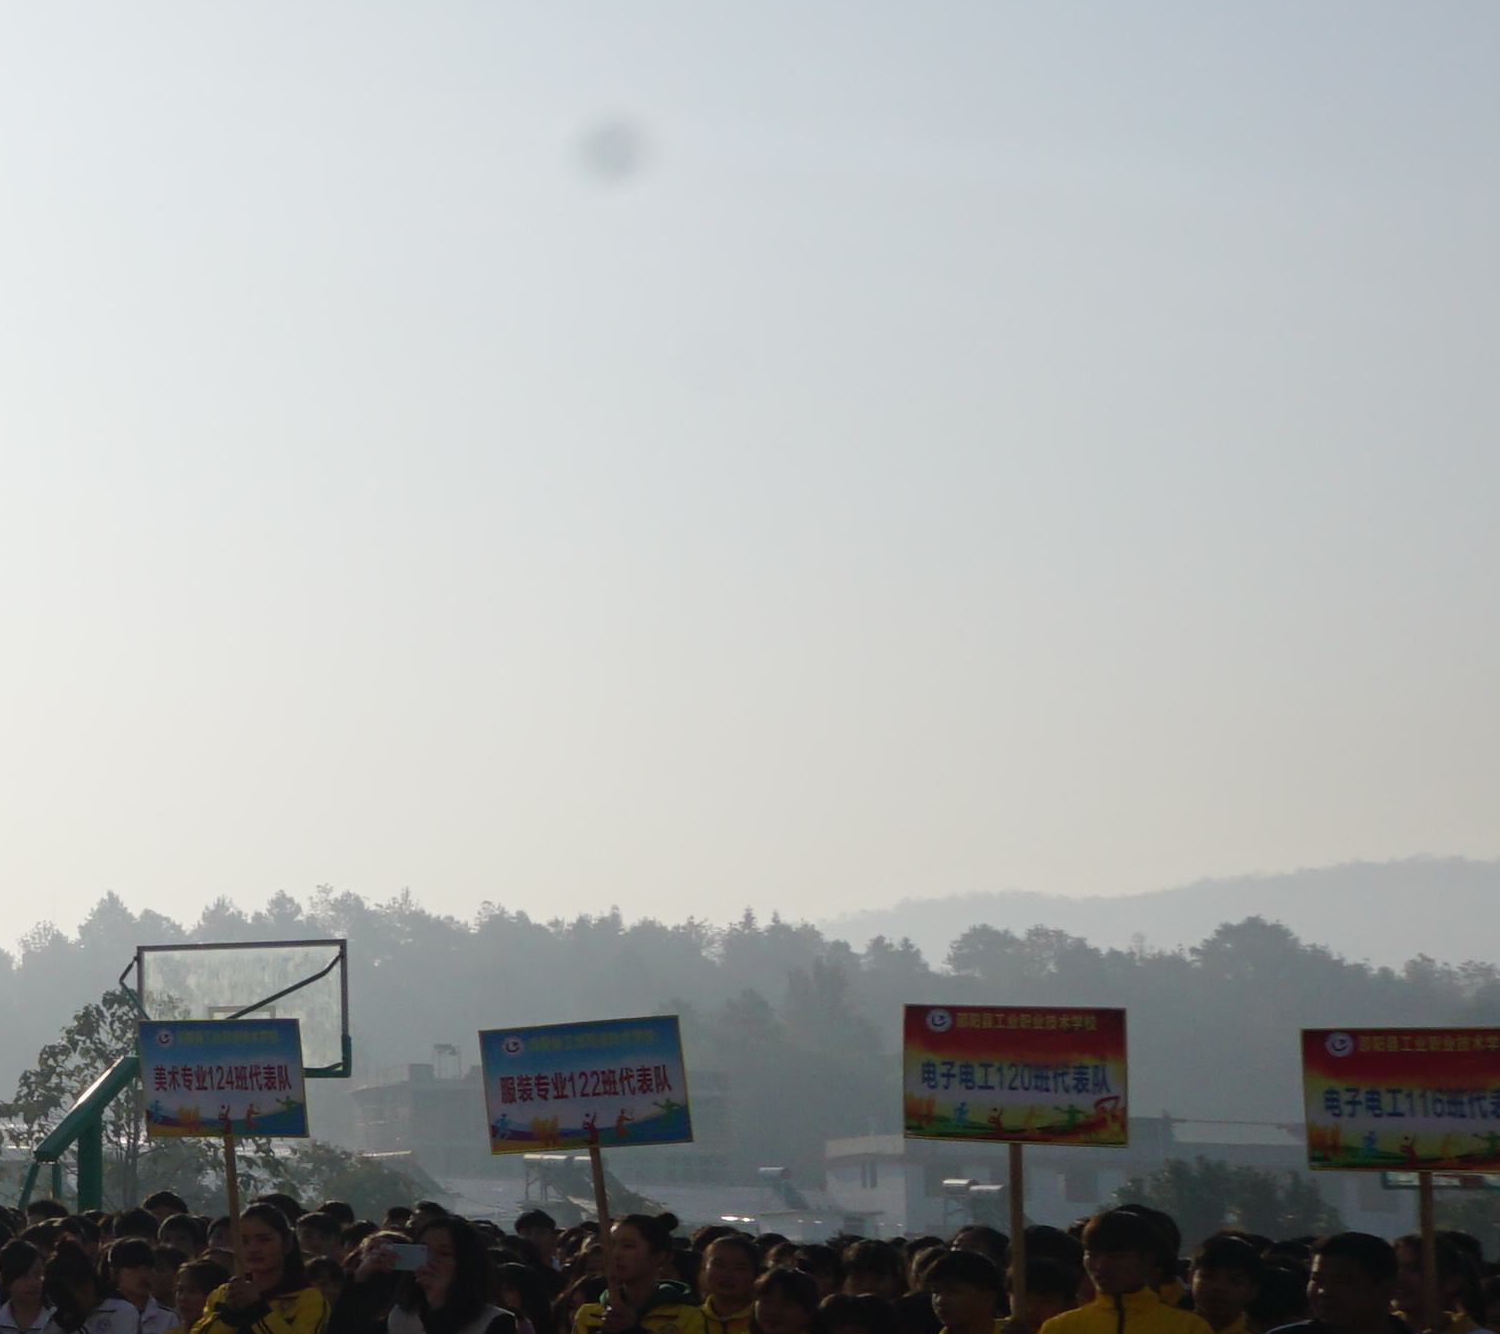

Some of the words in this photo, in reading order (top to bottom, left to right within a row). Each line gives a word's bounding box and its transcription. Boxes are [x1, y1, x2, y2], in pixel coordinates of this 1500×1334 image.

[153, 1064, 292, 1092] 美术专业124班代表队
[499, 1064, 673, 1104] 服装专业122班代表队
[921, 1059, 1111, 1095] 电子电工120班代表队
